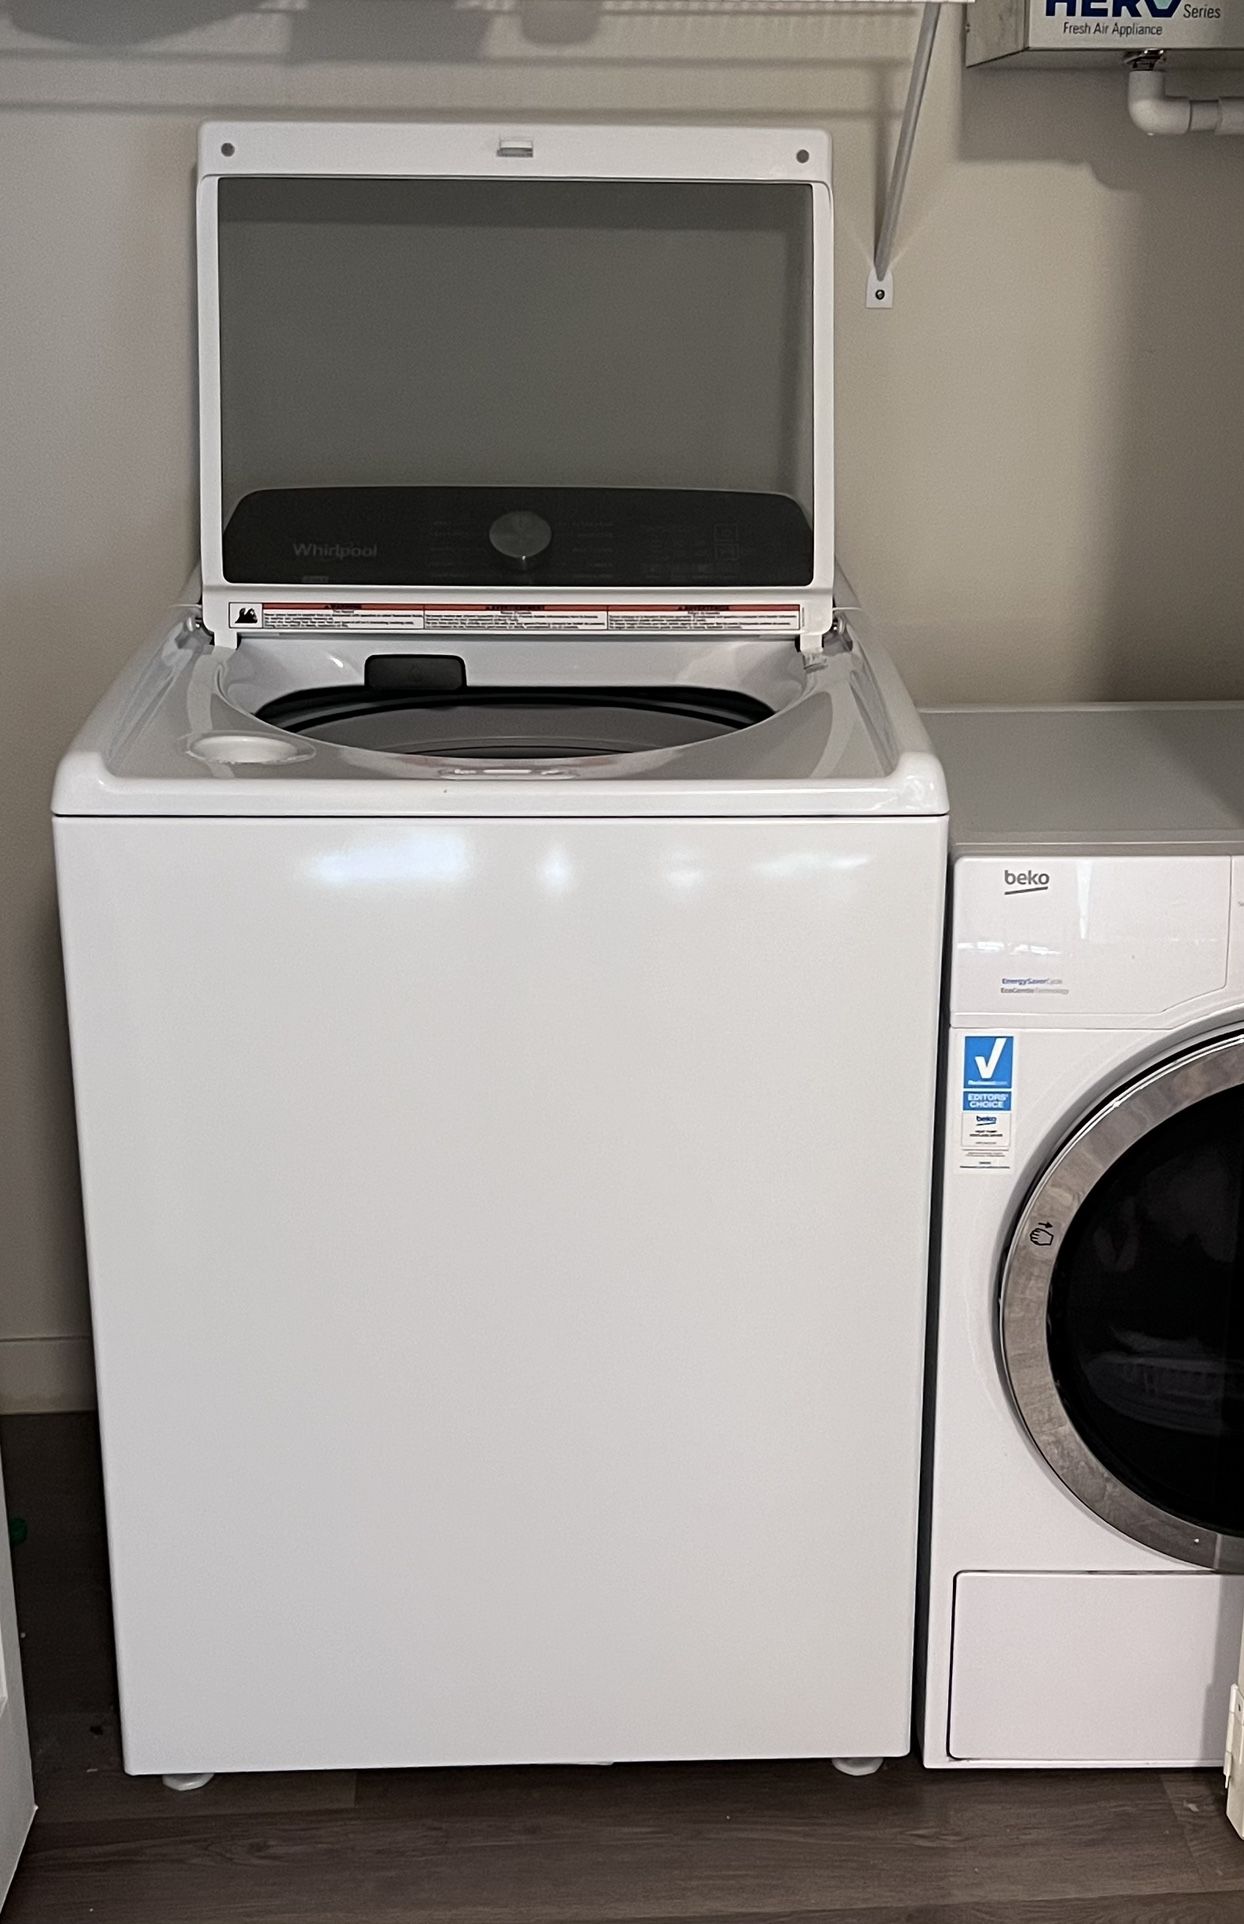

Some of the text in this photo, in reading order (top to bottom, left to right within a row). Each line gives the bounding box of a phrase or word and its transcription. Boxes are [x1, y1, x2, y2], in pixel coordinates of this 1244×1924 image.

[1183, 4, 1221, 19] Series
[1063, 22, 1163, 37] Fresh Air Appliance
[292, 543, 377, 559] Whirlpool
[1004, 869, 1050, 886] beko
